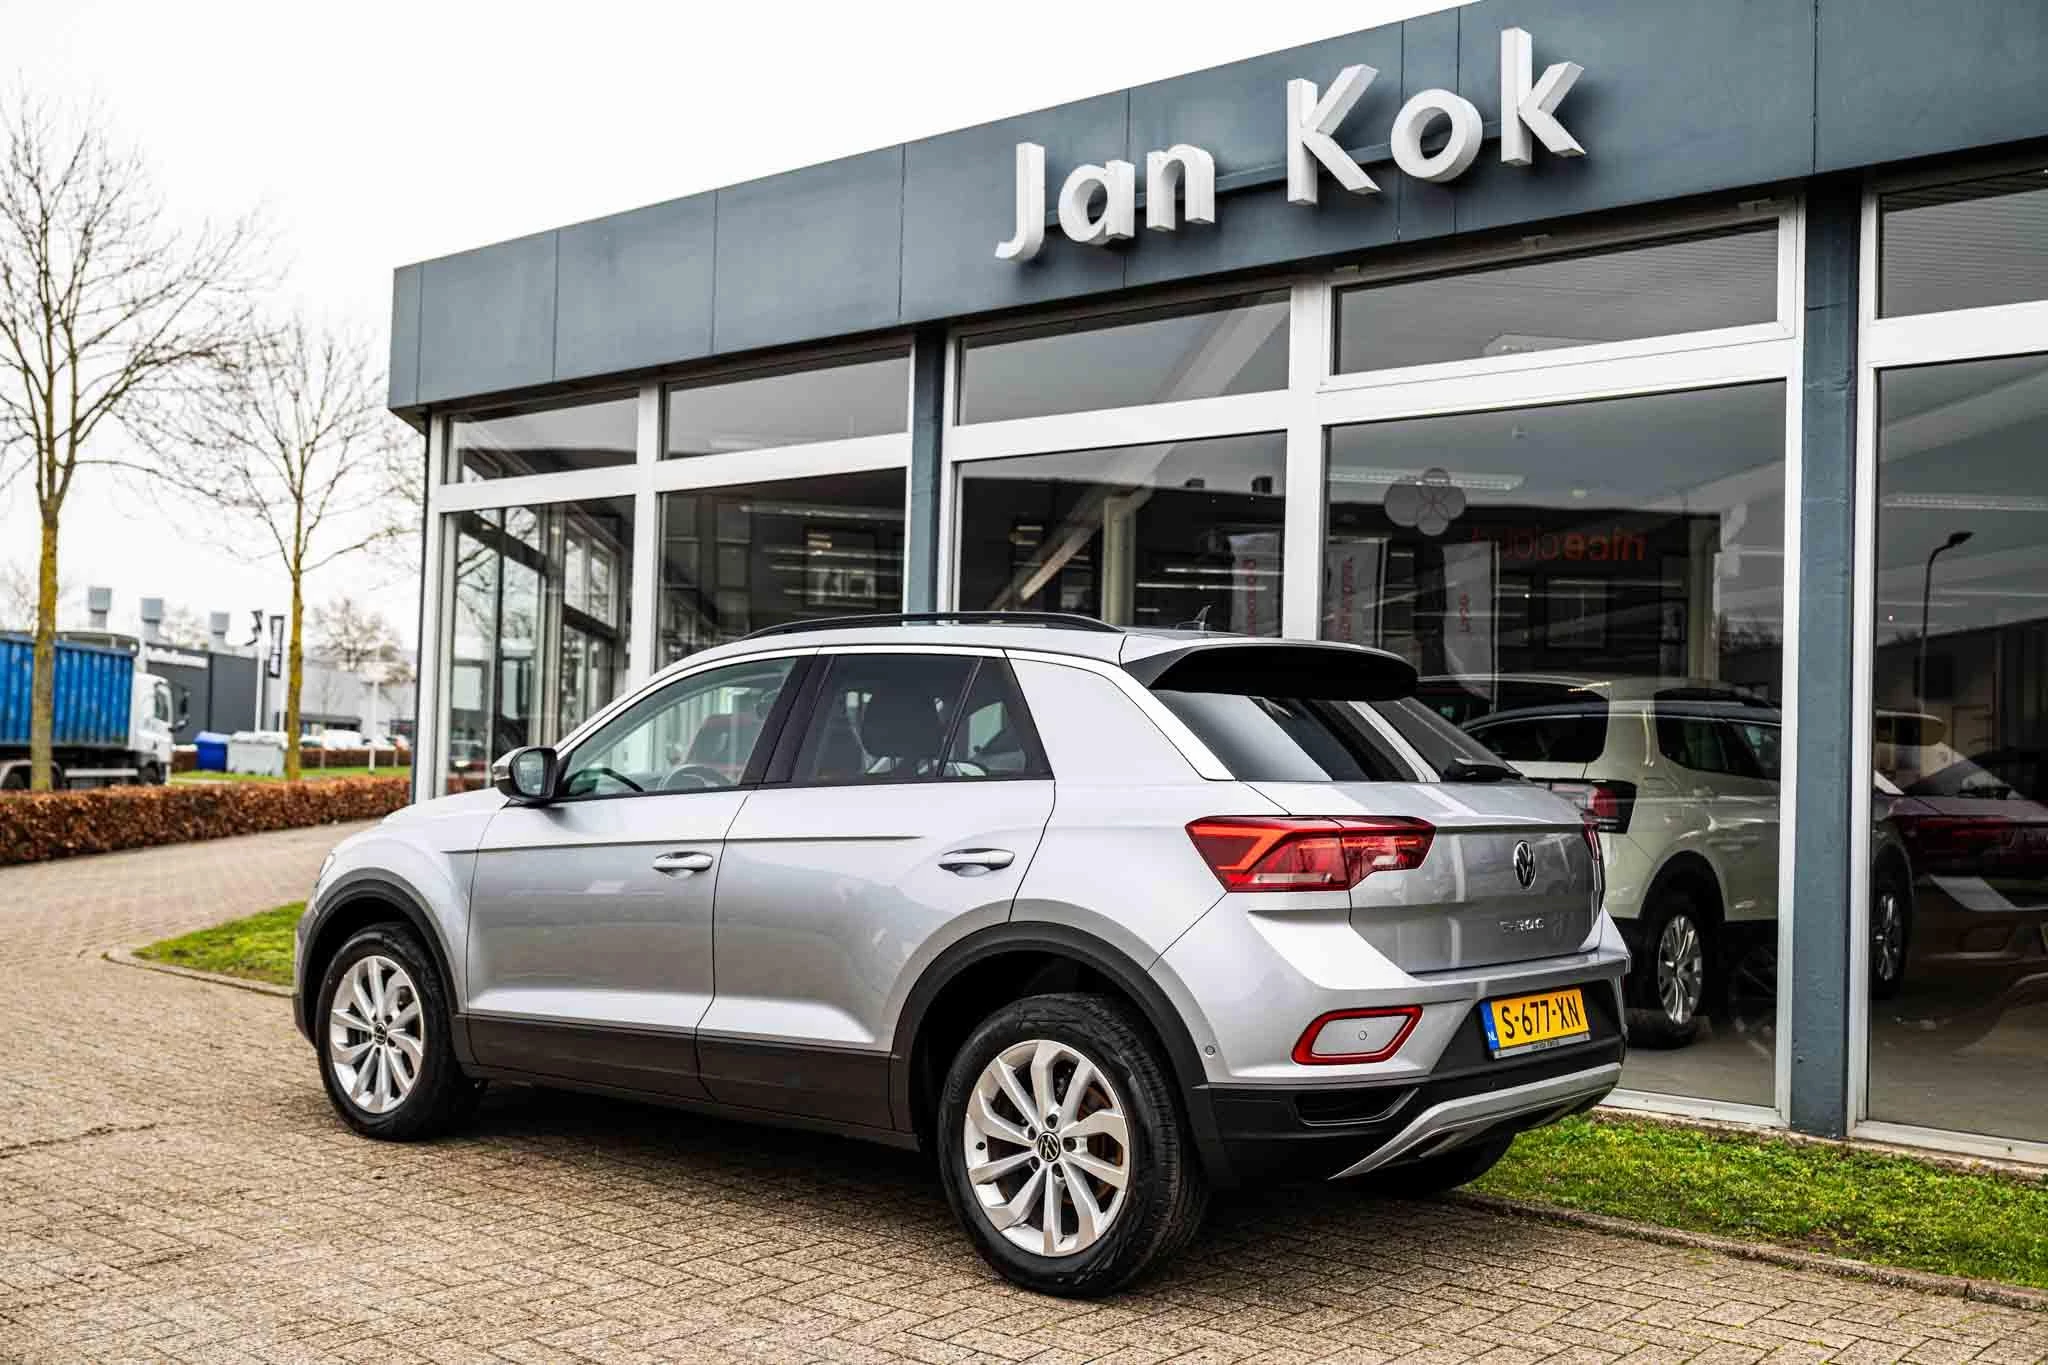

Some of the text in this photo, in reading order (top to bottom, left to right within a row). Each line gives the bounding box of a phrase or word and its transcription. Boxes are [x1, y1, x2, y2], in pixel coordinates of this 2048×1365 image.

[995, 27, 1586, 262] Jan Kok
[1501, 996, 1581, 1039] S-677-XN
